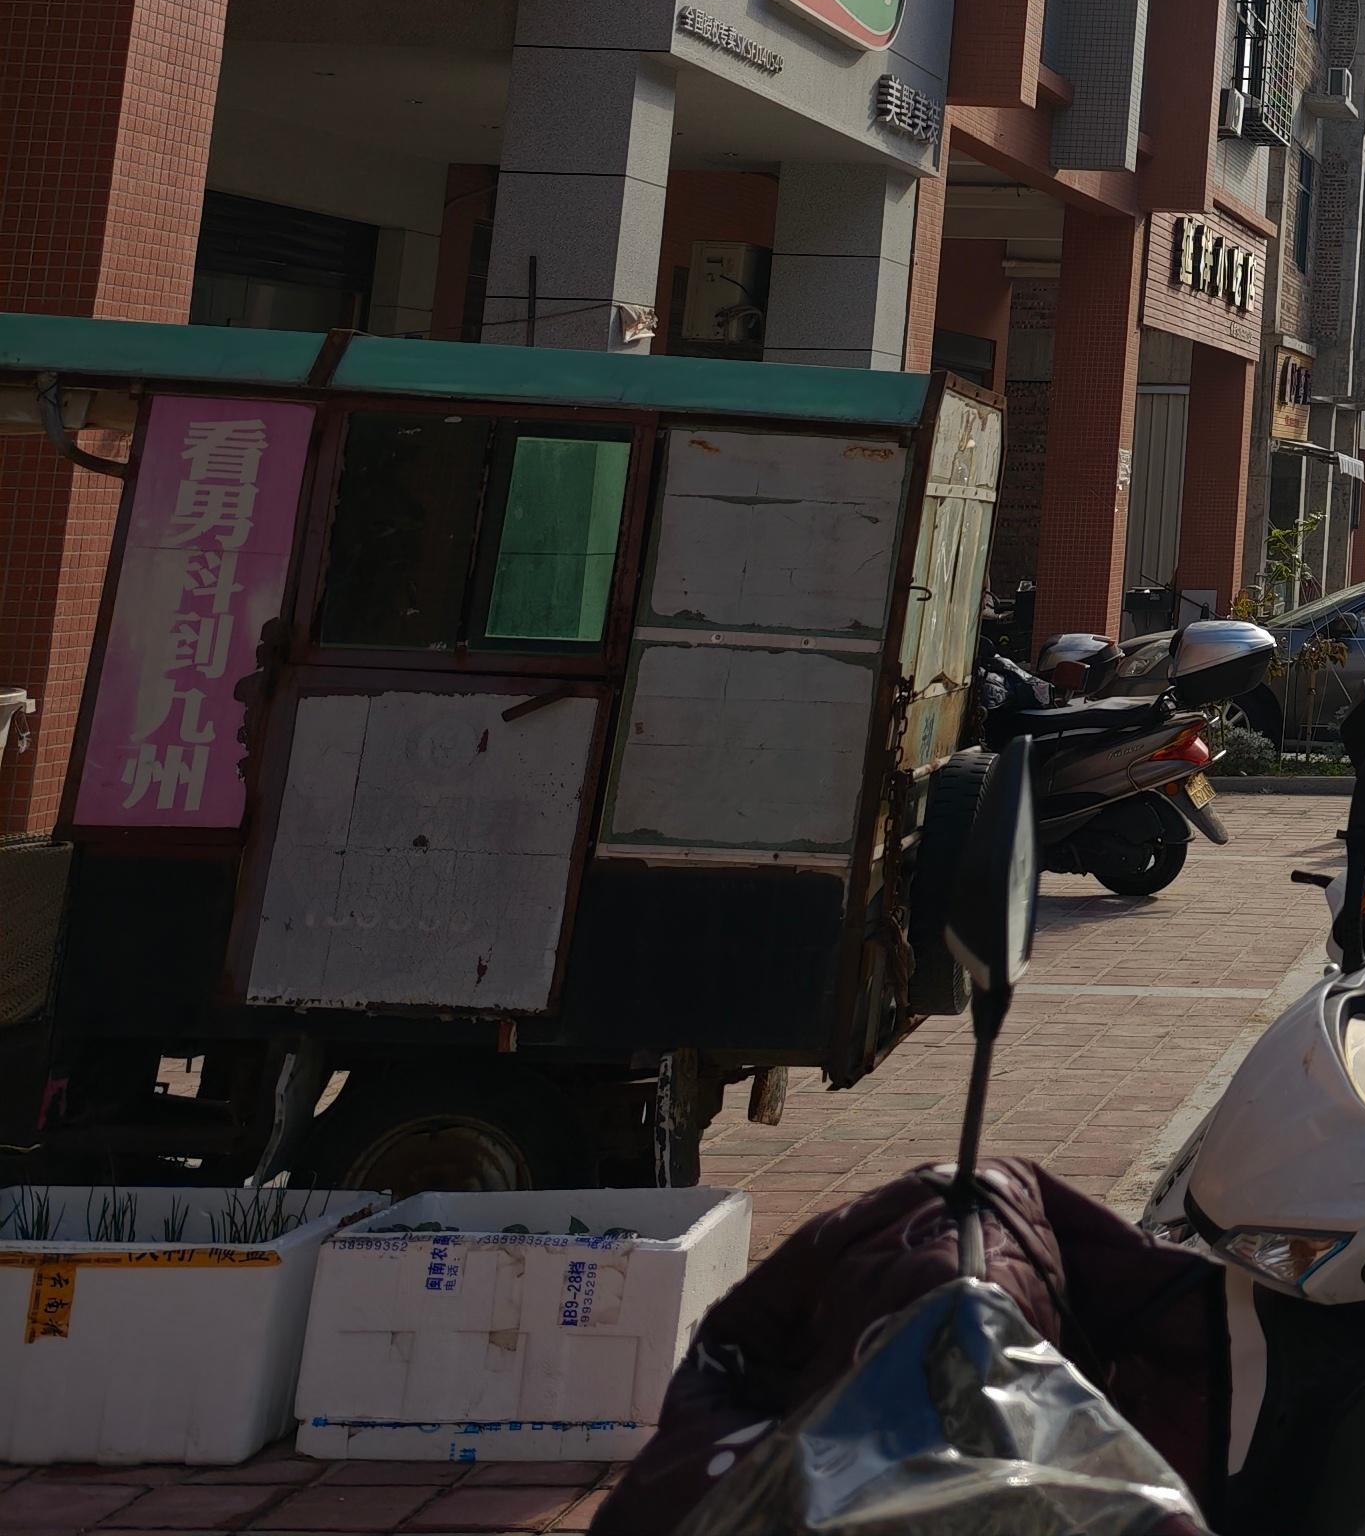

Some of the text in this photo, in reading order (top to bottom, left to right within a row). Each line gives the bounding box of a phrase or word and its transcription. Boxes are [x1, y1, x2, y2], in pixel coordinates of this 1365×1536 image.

[886, 74, 940, 144] 美墅美装
[122, 418, 268, 811] 看男科到九州
[580, 1263, 598, 1327] 9935298
